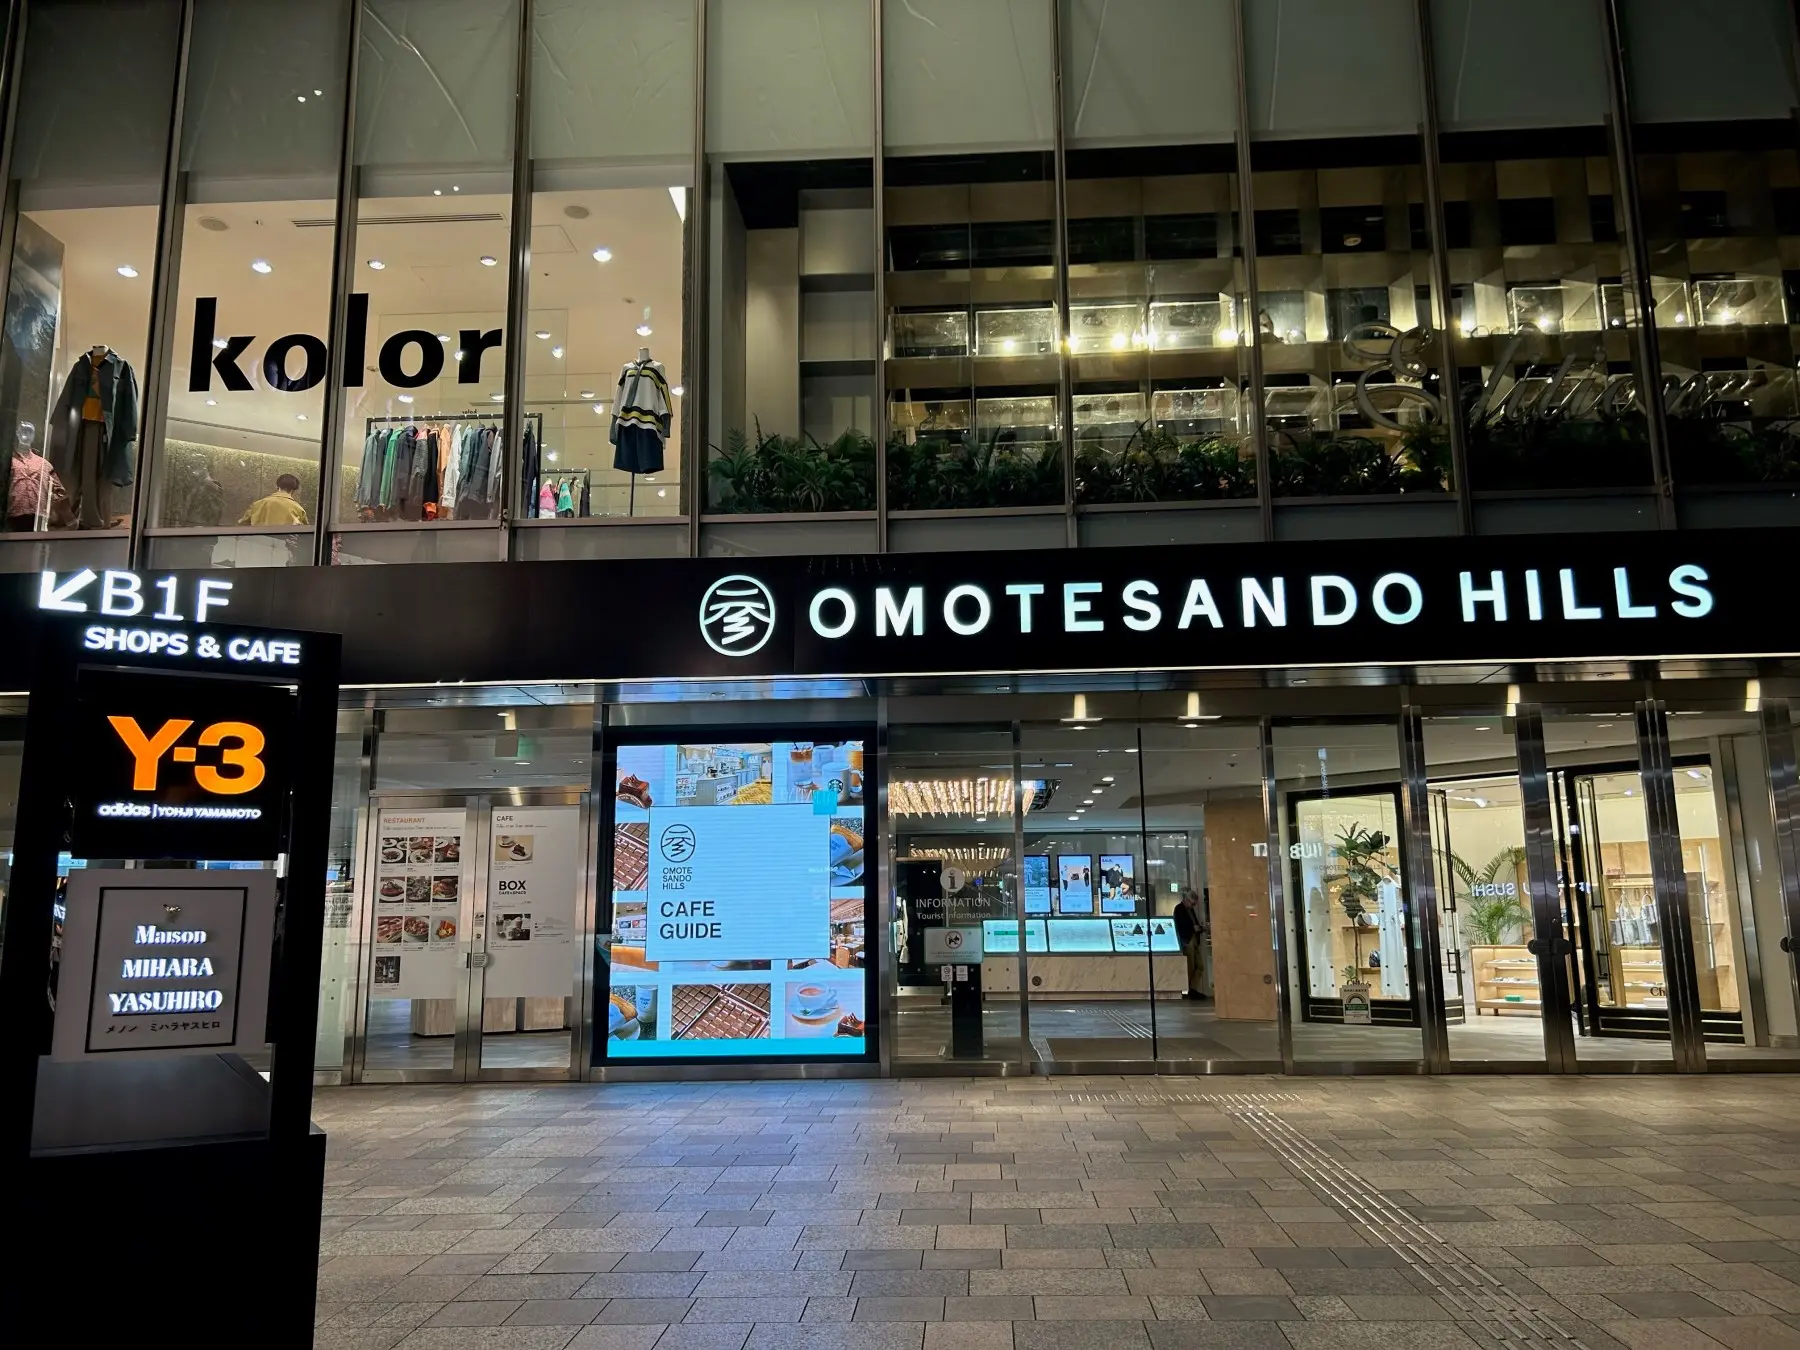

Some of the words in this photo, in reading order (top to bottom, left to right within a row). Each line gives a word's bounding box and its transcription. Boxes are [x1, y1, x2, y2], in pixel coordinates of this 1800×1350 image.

[188, 292, 502, 393] kolor
[100, 569, 233, 622] B1F
[809, 573, 1422, 639] OMOTESANDO
[1459, 564, 1713, 622] HILLS
[84, 626, 188, 656] SHOPS
[197, 636, 222, 658] &
[229, 638, 300, 664] CAFE
[107, 716, 265, 795] Y-3
[99, 802, 150, 817] adidas
[159, 805, 193, 818] YOHJI
[194, 807, 262, 819] YAMAMOTO
[662, 867, 693, 875] OMOTE
[498, 880, 527, 891] BOX
[660, 900, 716, 918] CAFE
[915, 897, 991, 908] INFORMATION
[917, 912, 944, 920] Tourist
[946, 911, 991, 919] nformation
[134, 925, 207, 944] Maison
[659, 922, 722, 940] GUIDE
[121, 957, 214, 979] MIHARA
[108, 990, 223, 1012] YASUHIRO
[150, 1021, 221, 1032] ミハラヤスヒロ
